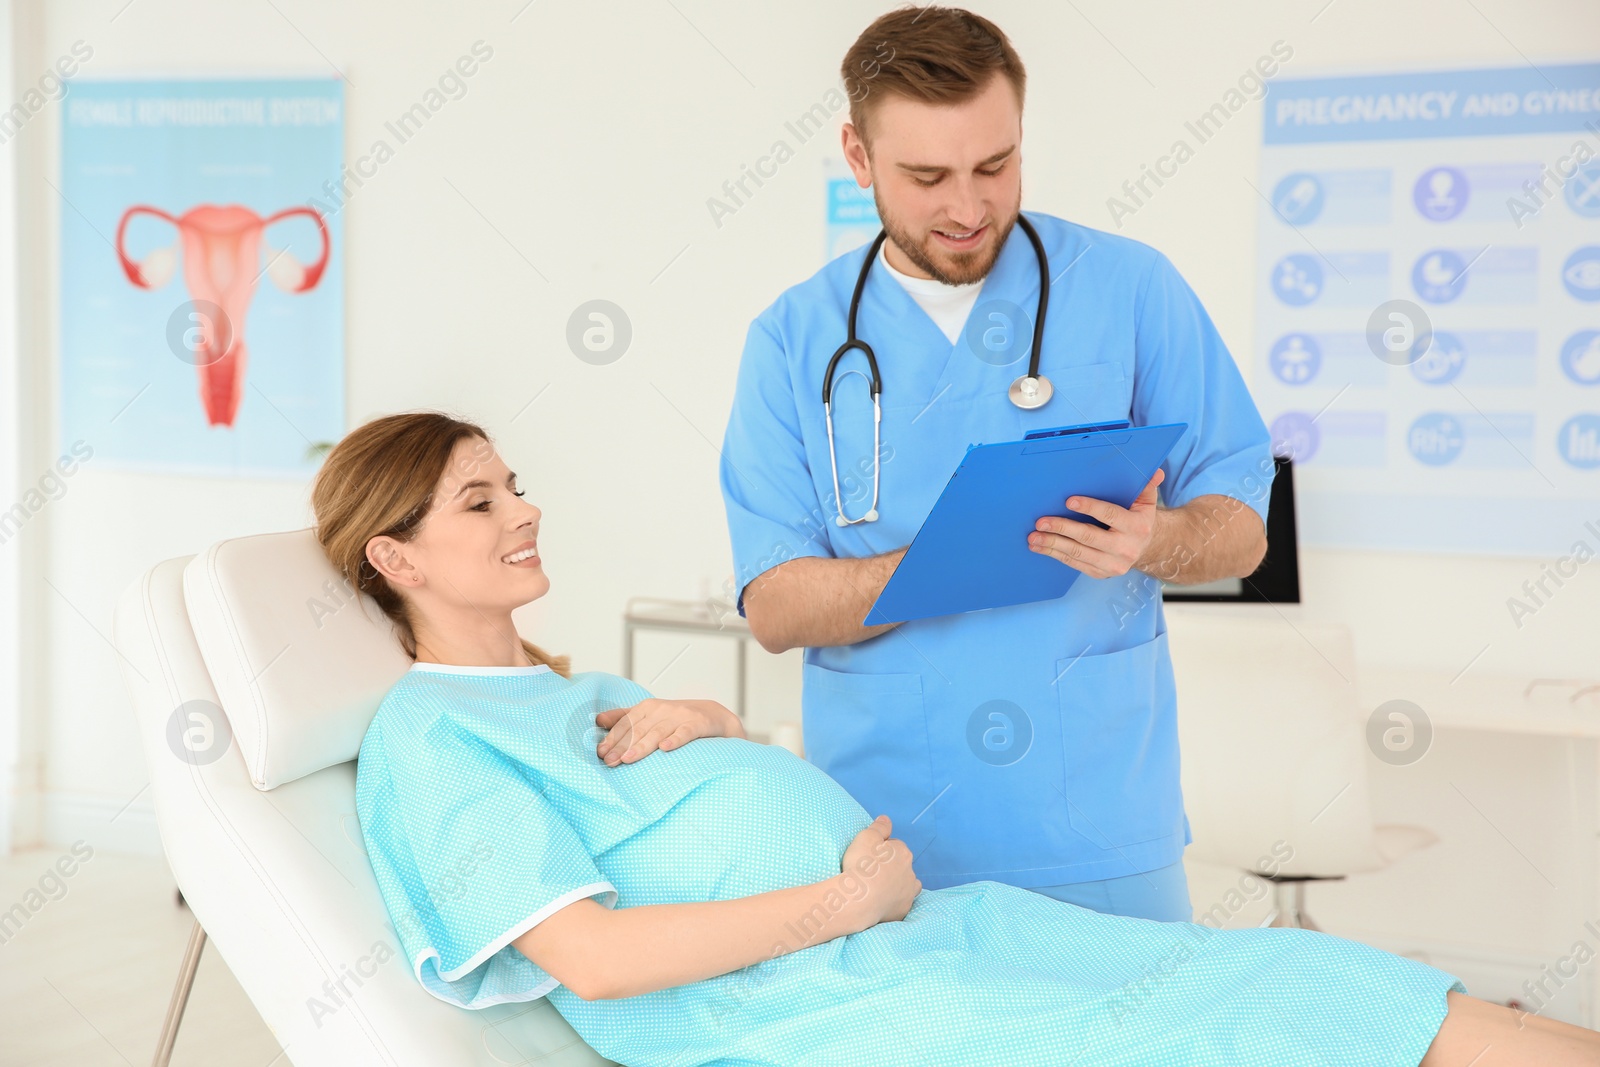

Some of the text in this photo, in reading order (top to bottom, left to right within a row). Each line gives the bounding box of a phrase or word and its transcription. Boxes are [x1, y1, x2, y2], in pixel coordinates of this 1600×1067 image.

[70, 97, 340, 127] FEMALE REPRODUCTIVE SYSTEM
[1276, 90, 1457, 127] PREGNANCY
[1462, 91, 1519, 117] AND
